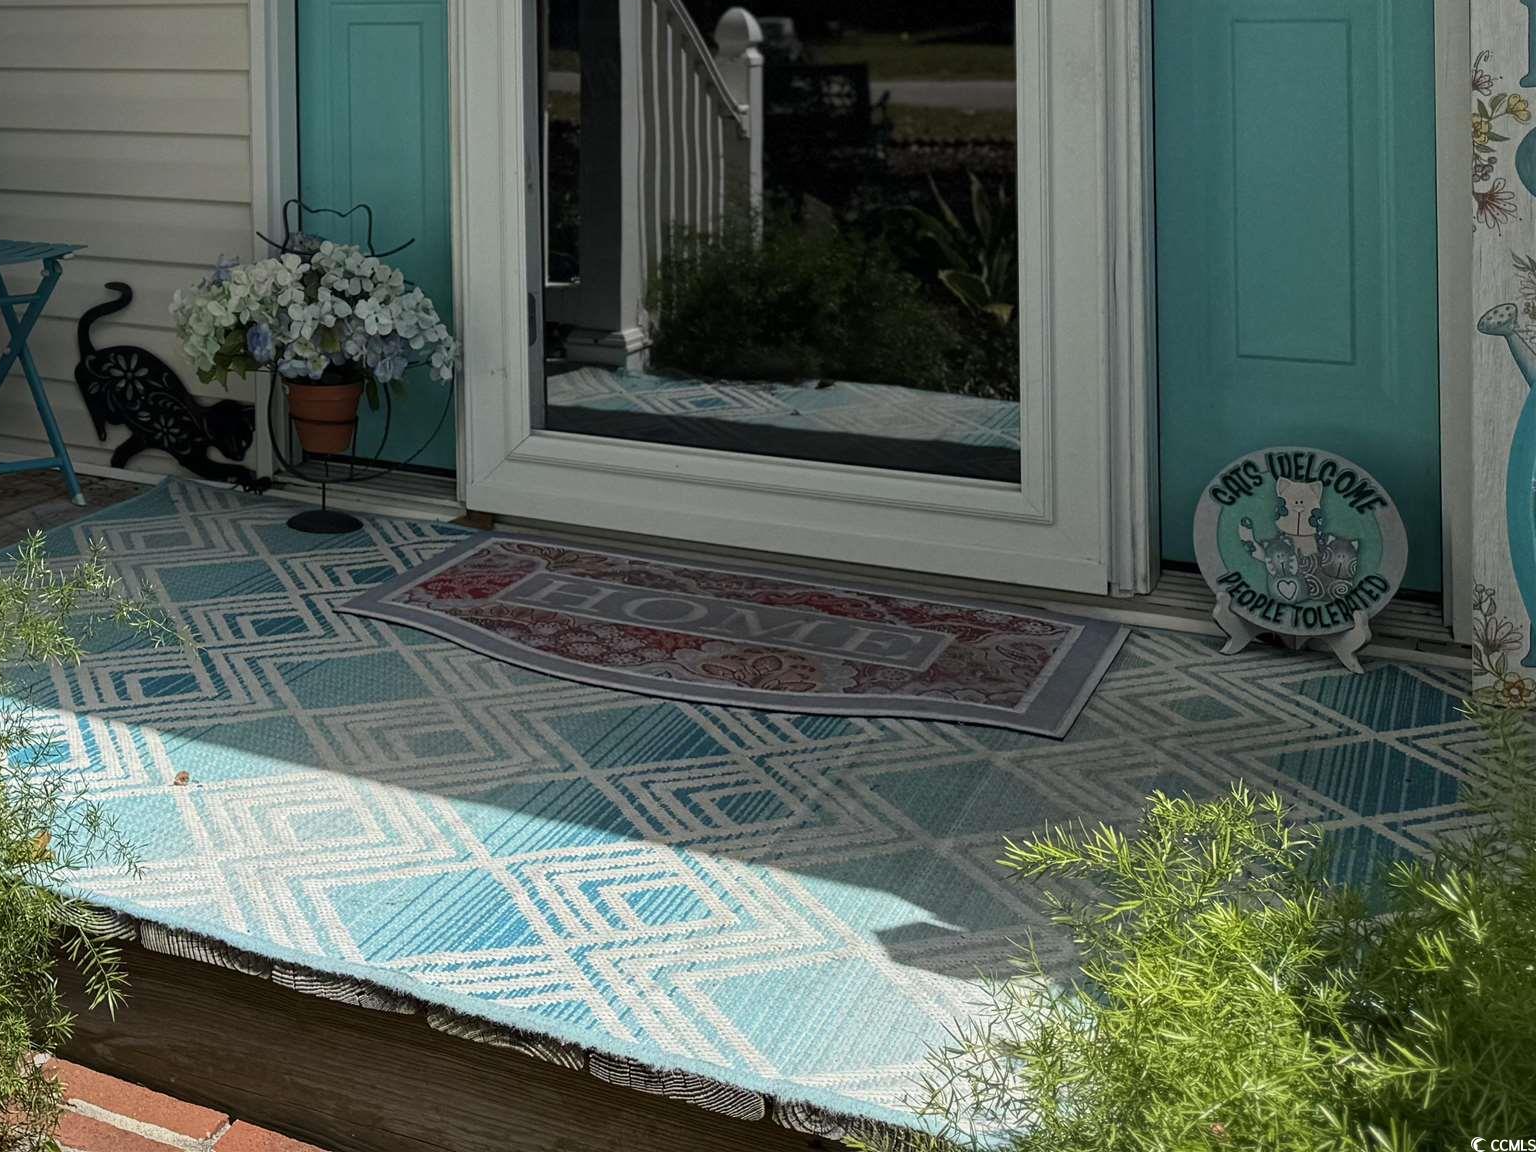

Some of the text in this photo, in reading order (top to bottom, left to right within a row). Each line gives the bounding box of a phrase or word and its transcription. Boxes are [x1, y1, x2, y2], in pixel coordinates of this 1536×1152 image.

[1211, 452, 1388, 515] CATS WELCOME
[516, 579, 924, 660] HOME
[1217, 571, 1389, 628] PEOPLE TOLERATED
